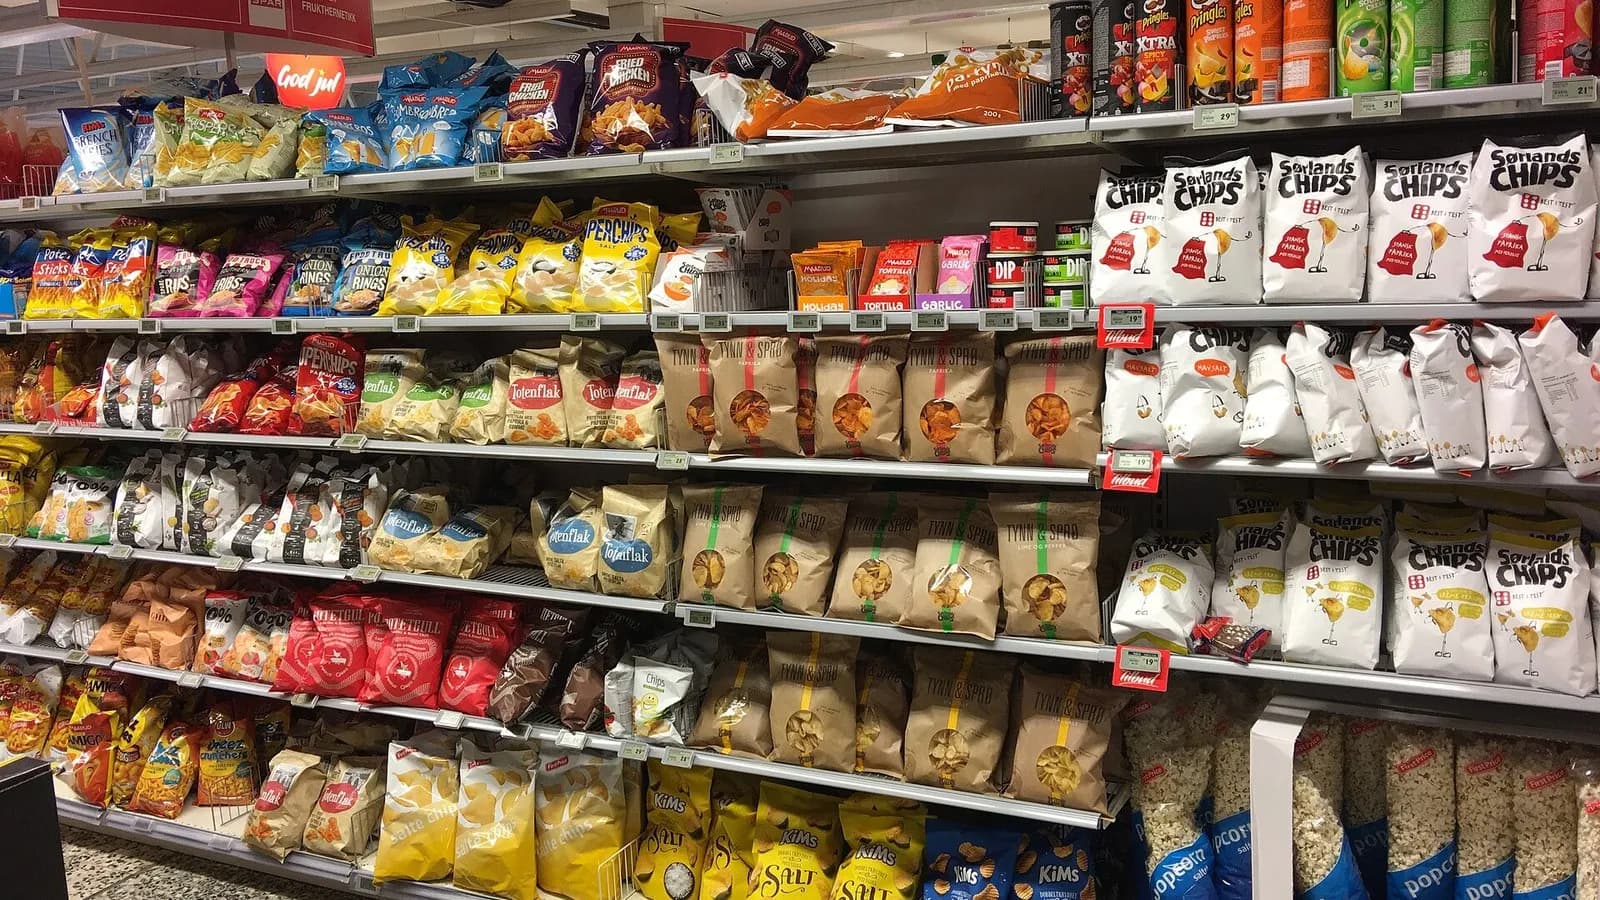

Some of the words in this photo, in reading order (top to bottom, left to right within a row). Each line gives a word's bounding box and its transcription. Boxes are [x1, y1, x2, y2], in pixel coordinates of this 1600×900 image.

[1142, 11, 1169, 31] Pringles
[1189, 6, 1226, 37] Pringles
[1136, 36, 1177, 54] XTRA
[614, 57, 644, 69] FRIED
[277, 64, 311, 88] God
[312, 71, 341, 96] jul
[610, 66, 651, 87] CHICKEN
[508, 89, 549, 104] CHICKEN
[519, 81, 545, 93] FRIED
[1490, 149, 1581, 166] Sørlands
[1280, 158, 1355, 177] Sørlands
[1383, 159, 1468, 179] Sørlands
[1490, 161, 1582, 191] CHIPS
[1174, 167, 1242, 189] Sørlands
[1278, 172, 1357, 199] CHIPS
[1383, 173, 1468, 202] CHIPS
[1174, 182, 1243, 212] CHIPS
[40, 263, 69, 276] Sticks
[301, 260, 333, 272] ONION
[356, 265, 390, 277] ONION
[995, 260, 1016, 280] DIP
[352, 277, 387, 292] RINGS
[1104, 329, 1145, 343] Tilbud
[672, 348, 696, 366] TYNN
[719, 341, 744, 359] TYNN
[746, 341, 755, 355] &
[910, 349, 934, 367] TYNN
[1019, 344, 1045, 361] TYNN
[511, 383, 561, 400] Totenflak
[1110, 473, 1150, 487] Tilbud
[928, 520, 952, 536] TYNN
[1006, 522, 1034, 541] TYNN
[1037, 524, 1046, 540] &
[1309, 538, 1379, 567] CHIPS
[1407, 548, 1486, 572] CHIPS
[1495, 562, 1573, 589] CHIPS
[645, 673, 666, 688] Chips
[1119, 671, 1160, 684] Tilbud
[954, 681, 964, 699] &
[1063, 698, 1073, 716] &
[654, 792, 687, 814] KiMs
[390, 819, 425, 845] salte
[780, 828, 819, 848] KiMs
[856, 843, 897, 867] KiMs
[761, 864, 818, 898] SALT
[953, 865, 978, 885] KiMs
[1038, 864, 1080, 885] KiMs
